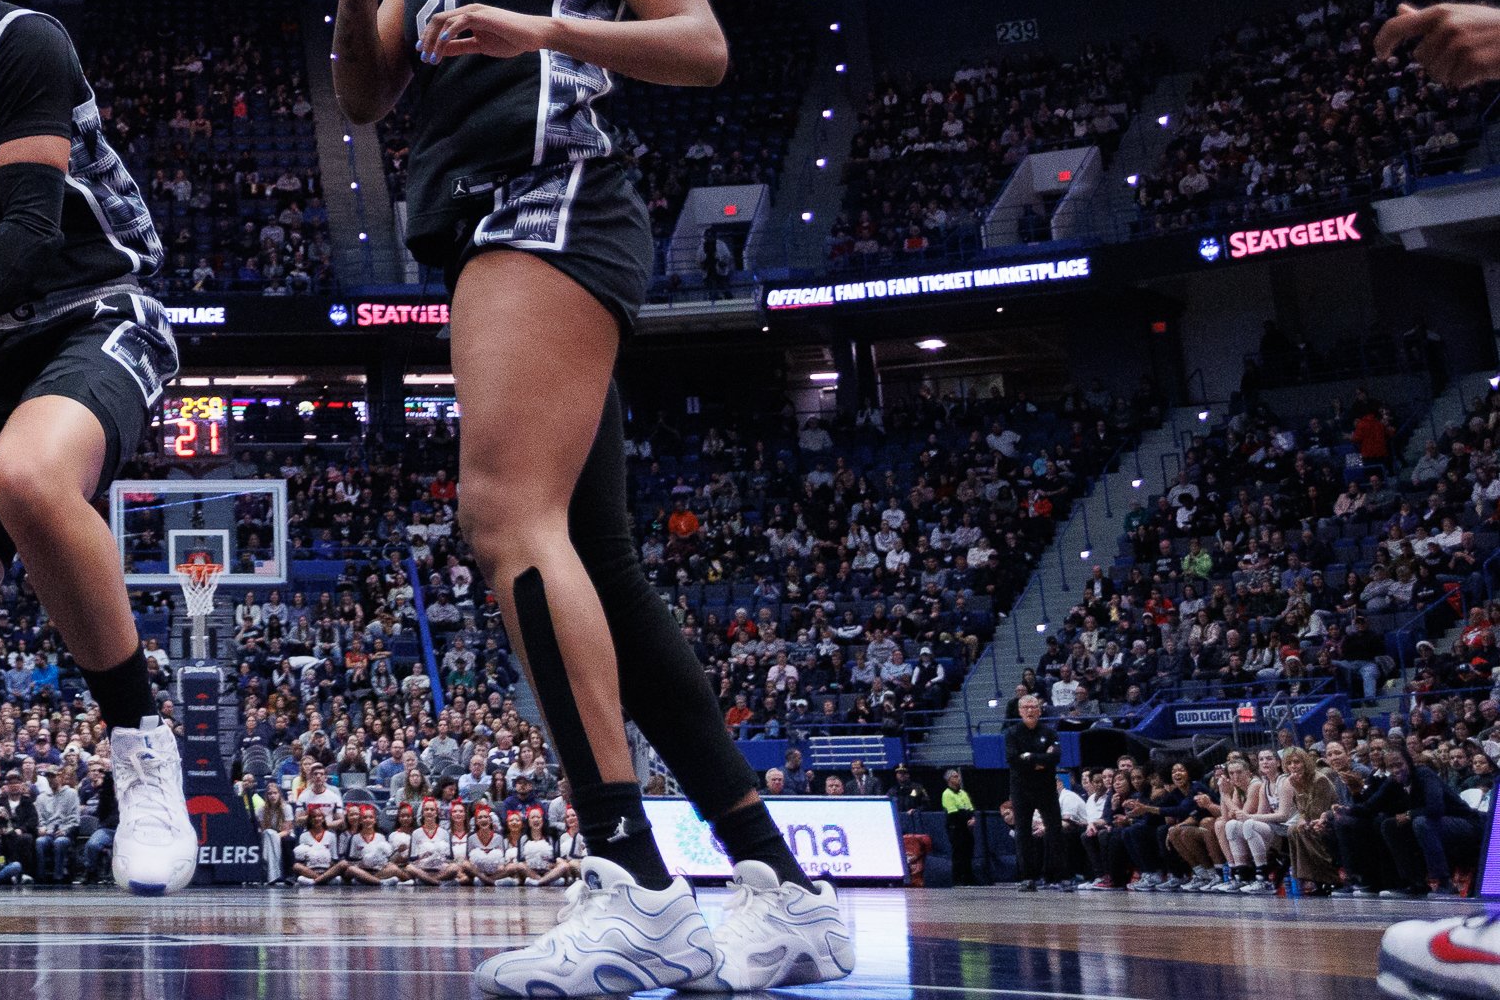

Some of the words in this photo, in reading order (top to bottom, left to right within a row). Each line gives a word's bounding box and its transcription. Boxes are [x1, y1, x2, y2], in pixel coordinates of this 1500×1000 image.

[997, 18, 1037, 43] 239
[1229, 212, 1361, 258] SEATGEEK
[767, 286, 834, 306] OFFICIAL
[835, 281, 865, 301] FAN
[866, 280, 885, 298] TO
[887, 277, 919, 296] FAN
[919, 271, 974, 293] TICKET
[974, 257, 1089, 287] MARKETPLACE
[165, 306, 225, 324] ETPLACE
[357, 303, 449, 326] SEATGEE
[175, 420, 219, 457] 21
[1177, 711, 1198, 722] BUD
[1200, 710, 1231, 721] LIGHT
[198, 846, 260, 864] ELERS
